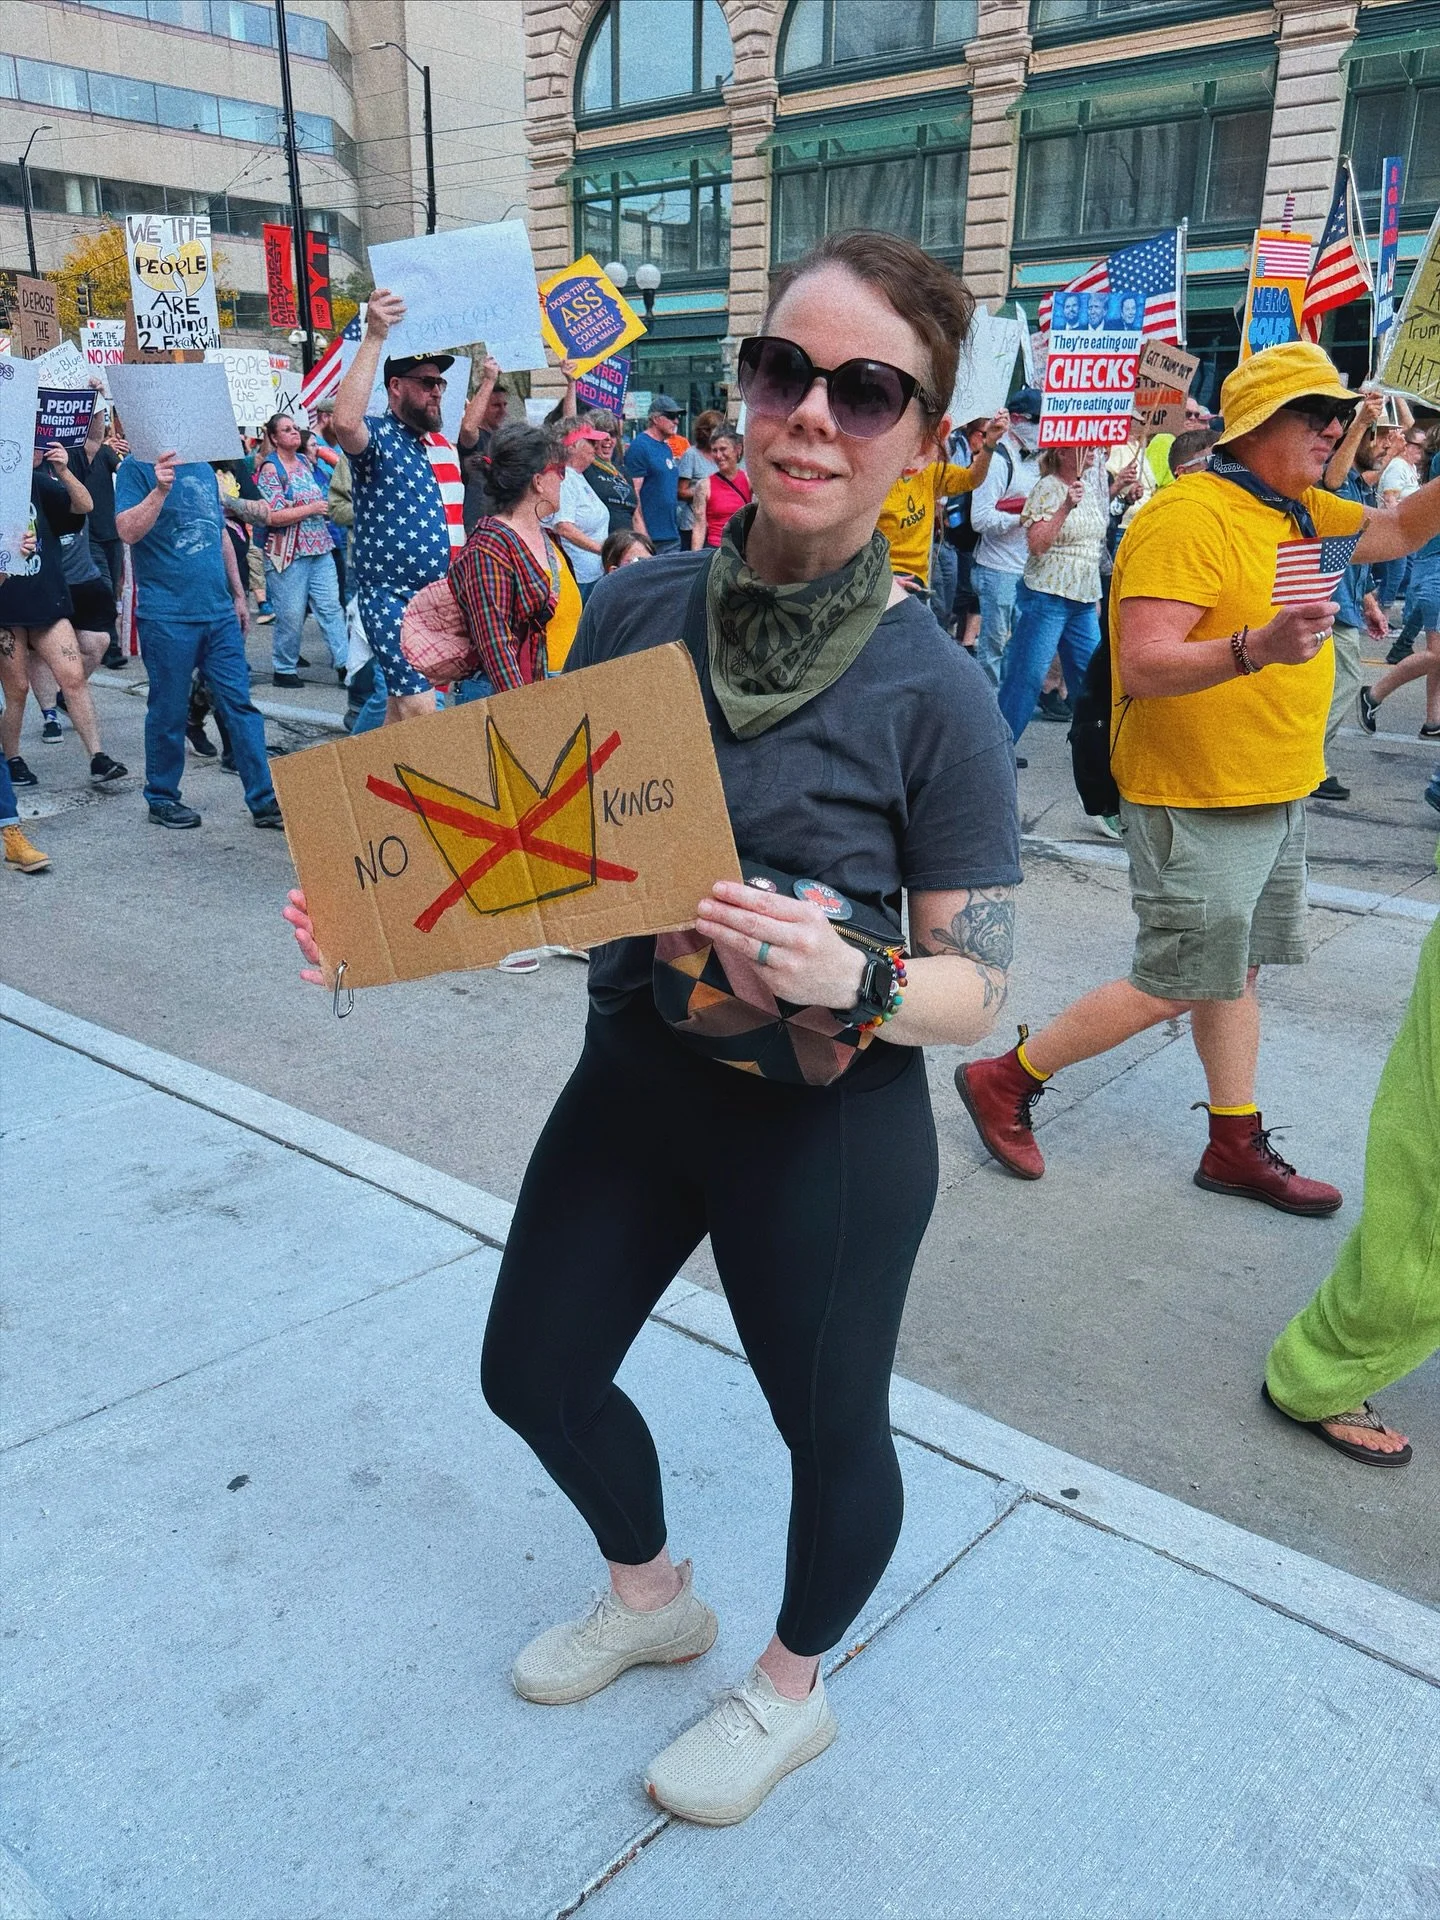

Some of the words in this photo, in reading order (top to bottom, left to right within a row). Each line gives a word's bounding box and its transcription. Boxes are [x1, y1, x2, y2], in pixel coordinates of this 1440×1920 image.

[127, 216, 162, 243] WE
[162, 217, 211, 244] THE
[135, 255, 207, 277] PEOPLE
[22, 289, 55, 314] DEPOSE
[150, 292, 200, 315] ARE
[283, 285, 296, 325] CITY
[549, 292, 571, 311] DOES
[570, 280, 590, 296] THIS
[561, 288, 603, 328] ASS
[1252, 286, 1290, 313] NERO
[34, 320, 49, 339] THE
[137, 311, 208, 336] nothing
[568, 315, 595, 337] MAKE
[595, 306, 610, 320] MY
[575, 314, 616, 346] COUNTRY
[1247, 317, 1292, 345] GOLFS
[1404, 314, 1440, 341] Trum
[88, 339, 112, 347] PEOPLE
[92, 331, 103, 339] WE
[105, 332, 117, 340] THE
[139, 331, 159, 350] 2
[582, 337, 600, 352] LOOK
[1054, 335, 1090, 352] They're
[1090, 335, 1122, 352] eating
[1121, 338, 1138, 349] our
[87, 349, 103, 364] NO
[105, 349, 124, 364] KIN
[1048, 358, 1136, 389] CHECKS
[47, 399, 93, 414] PEOPLE
[576, 381, 597, 400] RED
[599, 391, 620, 410] HAT
[1046, 397, 1081, 413] They're
[1083, 397, 1114, 413] eating
[1114, 399, 1131, 411] our
[41, 415, 75, 425] RIGHTS
[75, 416, 89, 424] AND
[55, 426, 87, 437] DIGNITY.
[1040, 419, 1127, 442] BALANCES
[765, 583, 858, 691] RESIST
[603, 778, 675, 827] KINGS
[354, 835, 410, 891] NO
